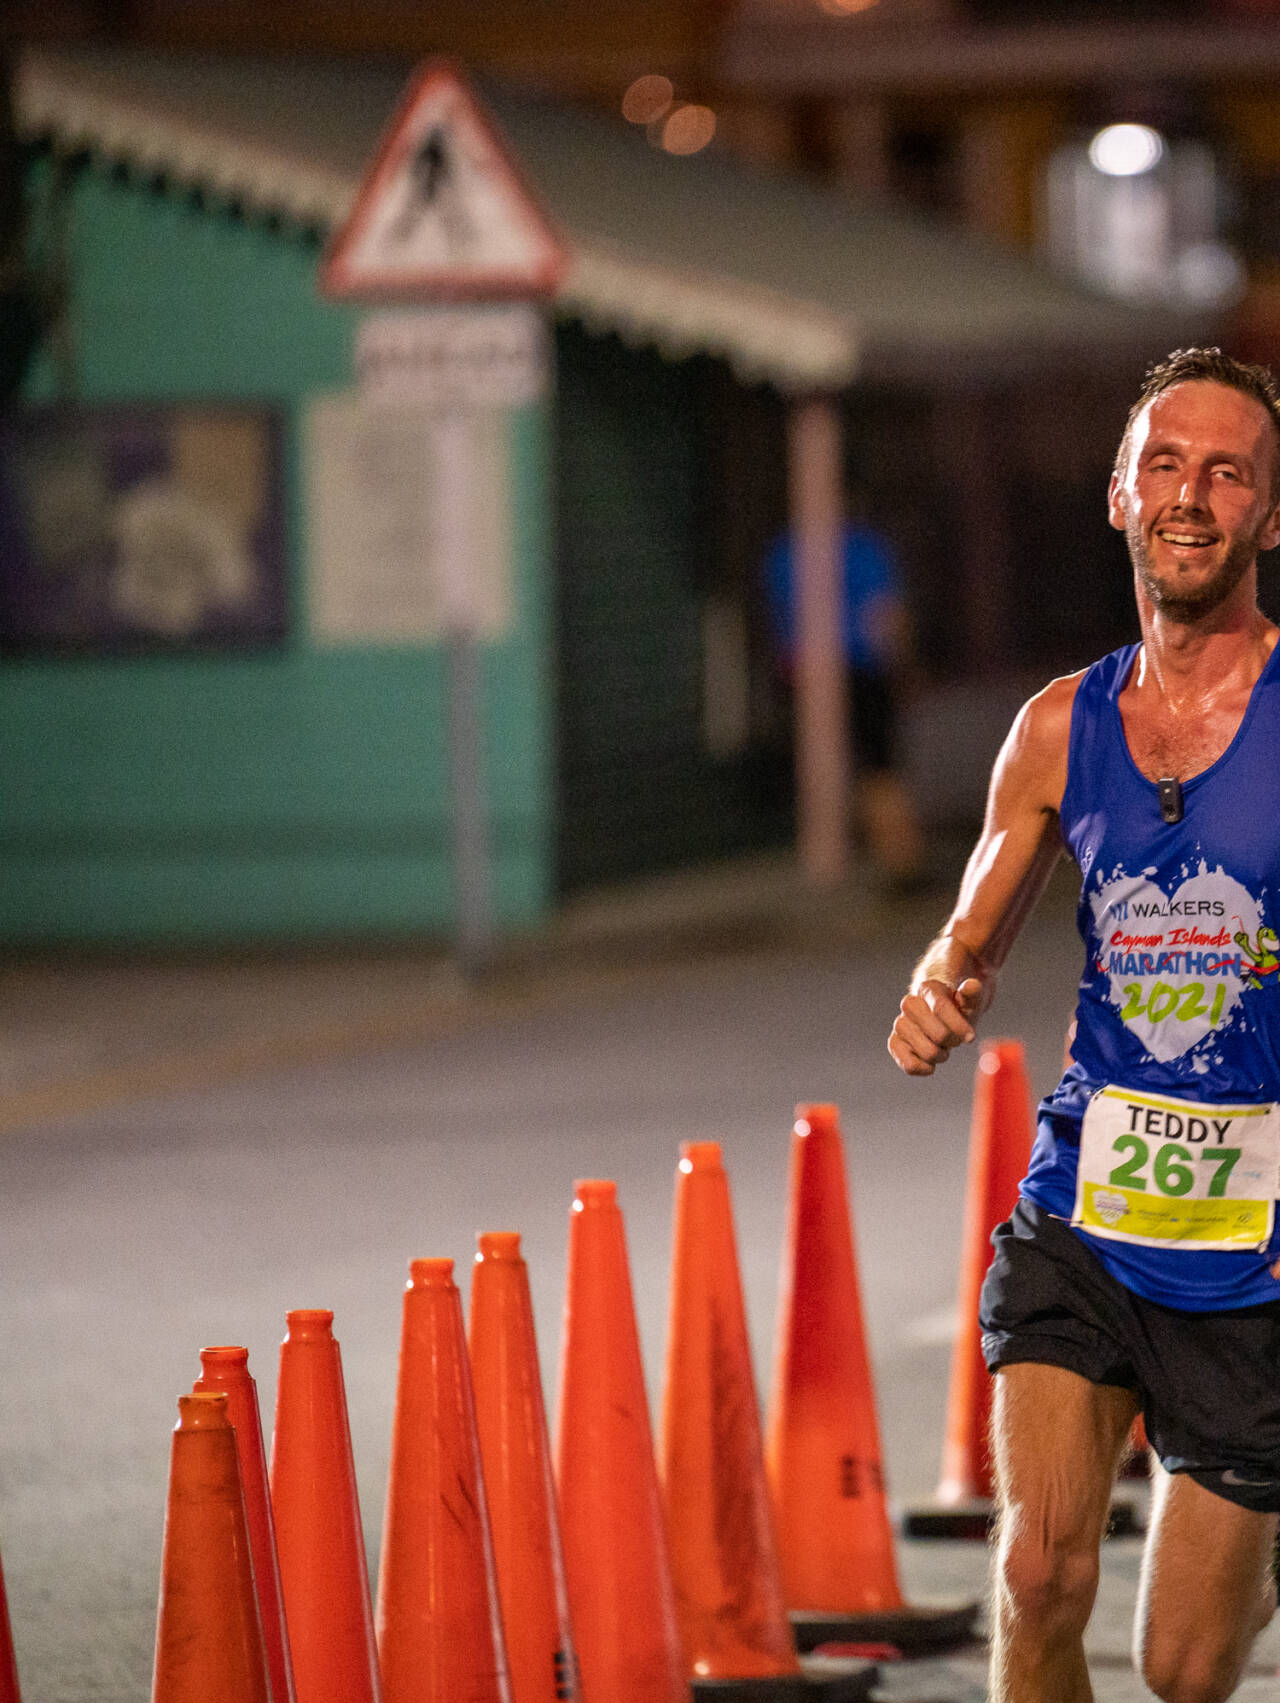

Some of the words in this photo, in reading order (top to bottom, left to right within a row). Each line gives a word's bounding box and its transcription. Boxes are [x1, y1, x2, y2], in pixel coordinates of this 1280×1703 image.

[1132, 901, 1226, 918] WALKERS
[1110, 930, 1164, 954] Cayman
[1168, 926, 1232, 947] Islands
[1109, 951, 1241, 977] MARATHON
[1120, 981, 1227, 1028] 2021
[1127, 1104, 1232, 1144] TEDDY
[1109, 1134, 1242, 1198] 267
